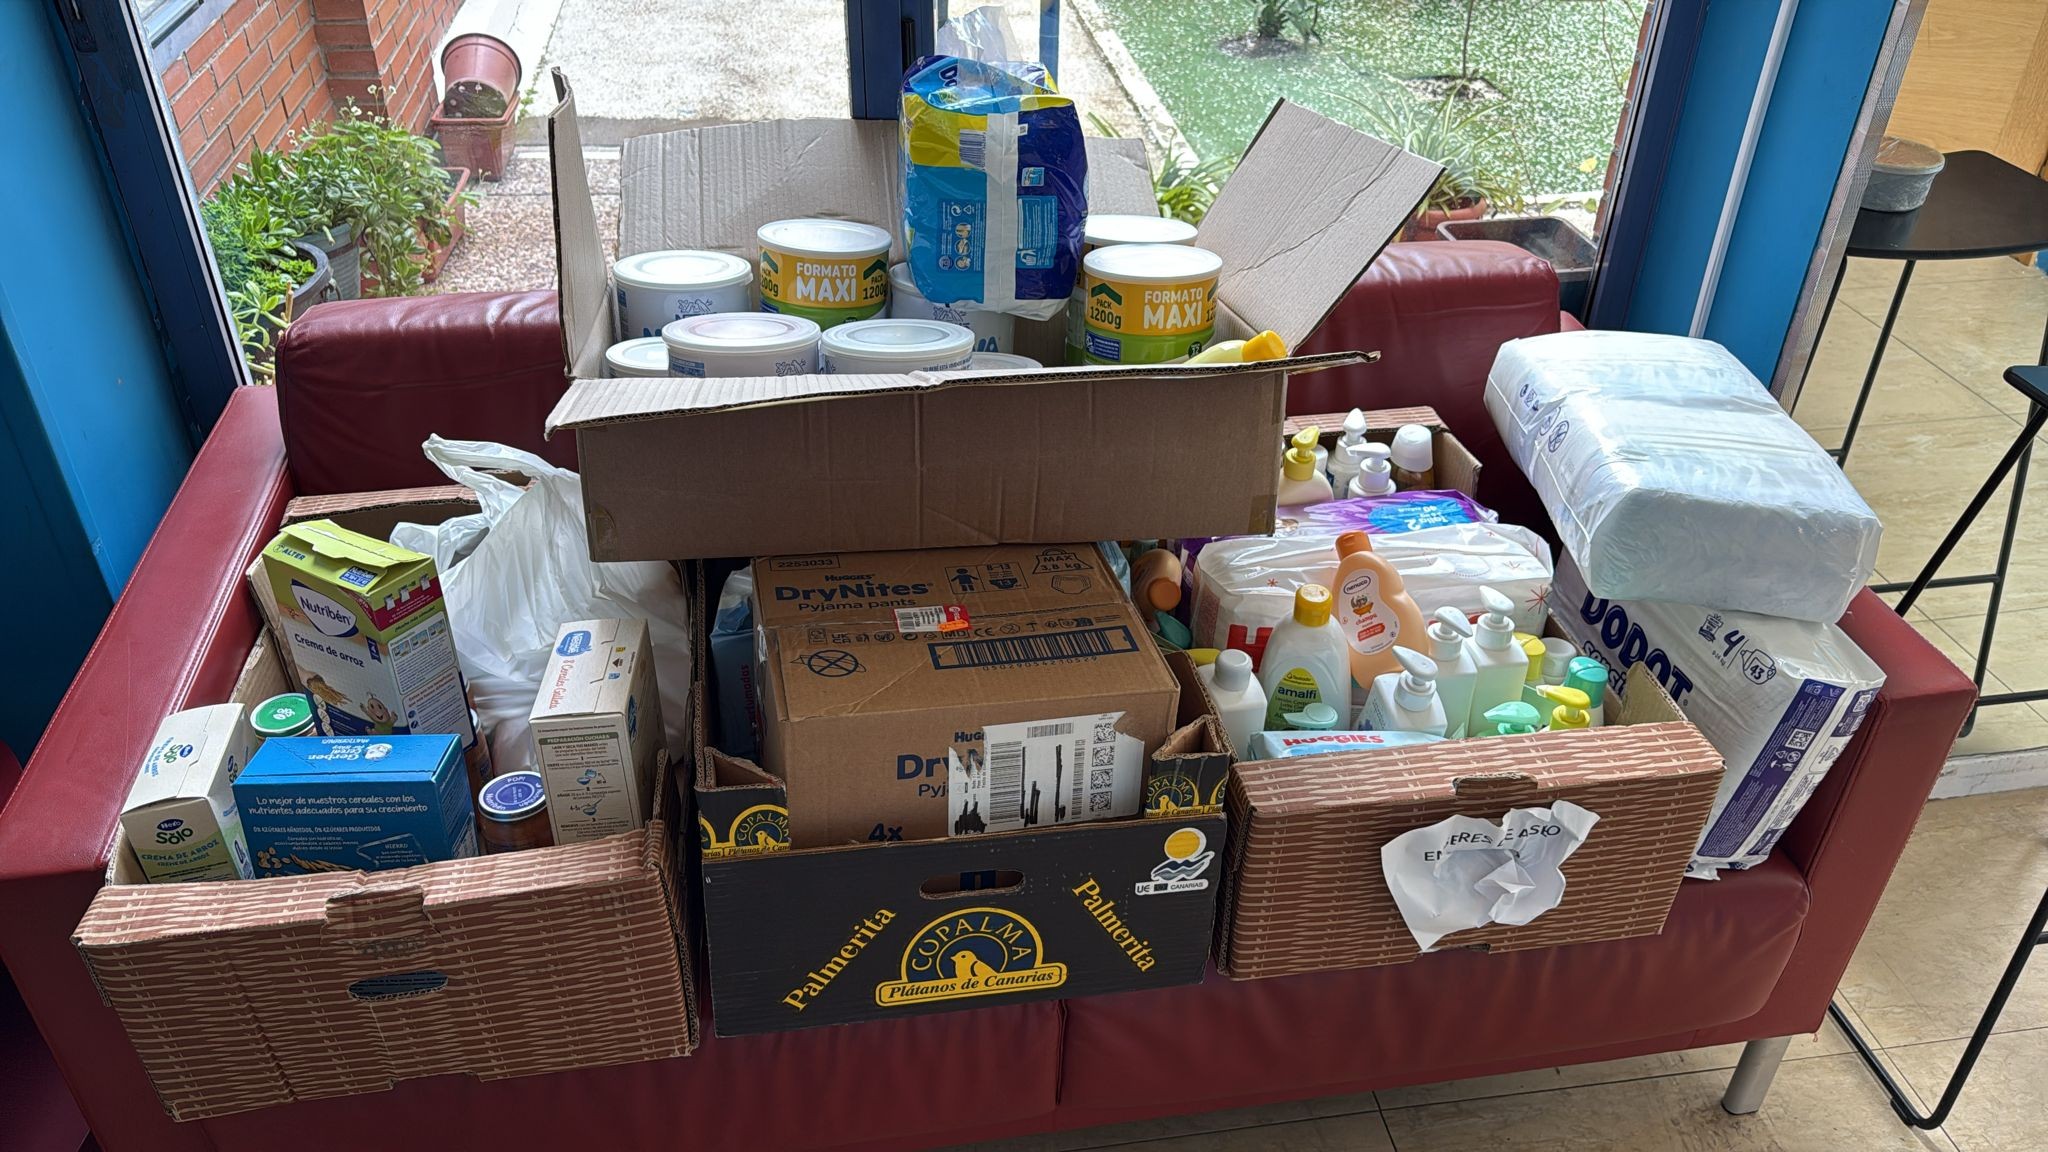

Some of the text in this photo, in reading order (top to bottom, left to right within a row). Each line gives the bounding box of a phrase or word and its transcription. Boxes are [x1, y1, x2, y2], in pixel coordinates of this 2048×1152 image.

[796, 262, 857, 277] FORMATO
[796, 276, 857, 302] MAXI
[1144, 287, 1203, 304] FORMATO
[1096, 298, 1112, 310] PACK
[1090, 307, 1122, 330] 1200g
[1143, 301, 1202, 330] MAXI
[1404, 519, 1422, 530] 2
[281, 548, 306, 561] ALTER
[778, 559, 833, 568] 2253033
[986, 563, 1011, 571] 8-13
[1064, 562, 1082, 570] kg
[775, 581, 929, 602] DryNites
[1346, 580, 1368, 592] nenuco
[300, 596, 351, 625] Nutribén
[798, 599, 916, 612] Pyjama pants
[294, 633, 365, 668] Crema de arroz
[1580, 591, 1693, 702] DODOT
[1723, 630, 1745, 657] 4
[1750, 664, 1765, 681] 43
[1277, 686, 1317, 700] amalfi
[1283, 734, 1384, 747] HUGGIES
[248, 804, 428, 815] nutrientes adecuados para su crecimiento
[256, 797, 267, 805] Lo
[269, 796, 294, 807] mejor
[296, 796, 306, 804] de
[307, 796, 347, 804] nuestros
[348, 795, 384, 804] cereales
[402, 795, 415, 803] los
[869, 823, 904, 841] 4x
[1137, 882, 1204, 893] UE CANARIAS
[1072, 878, 1157, 974] Palmerita
[912, 915, 1033, 972] COPALMA
[782, 905, 897, 1011] Palmerita
[888, 969, 1055, 999] Plátanos de Canarias
